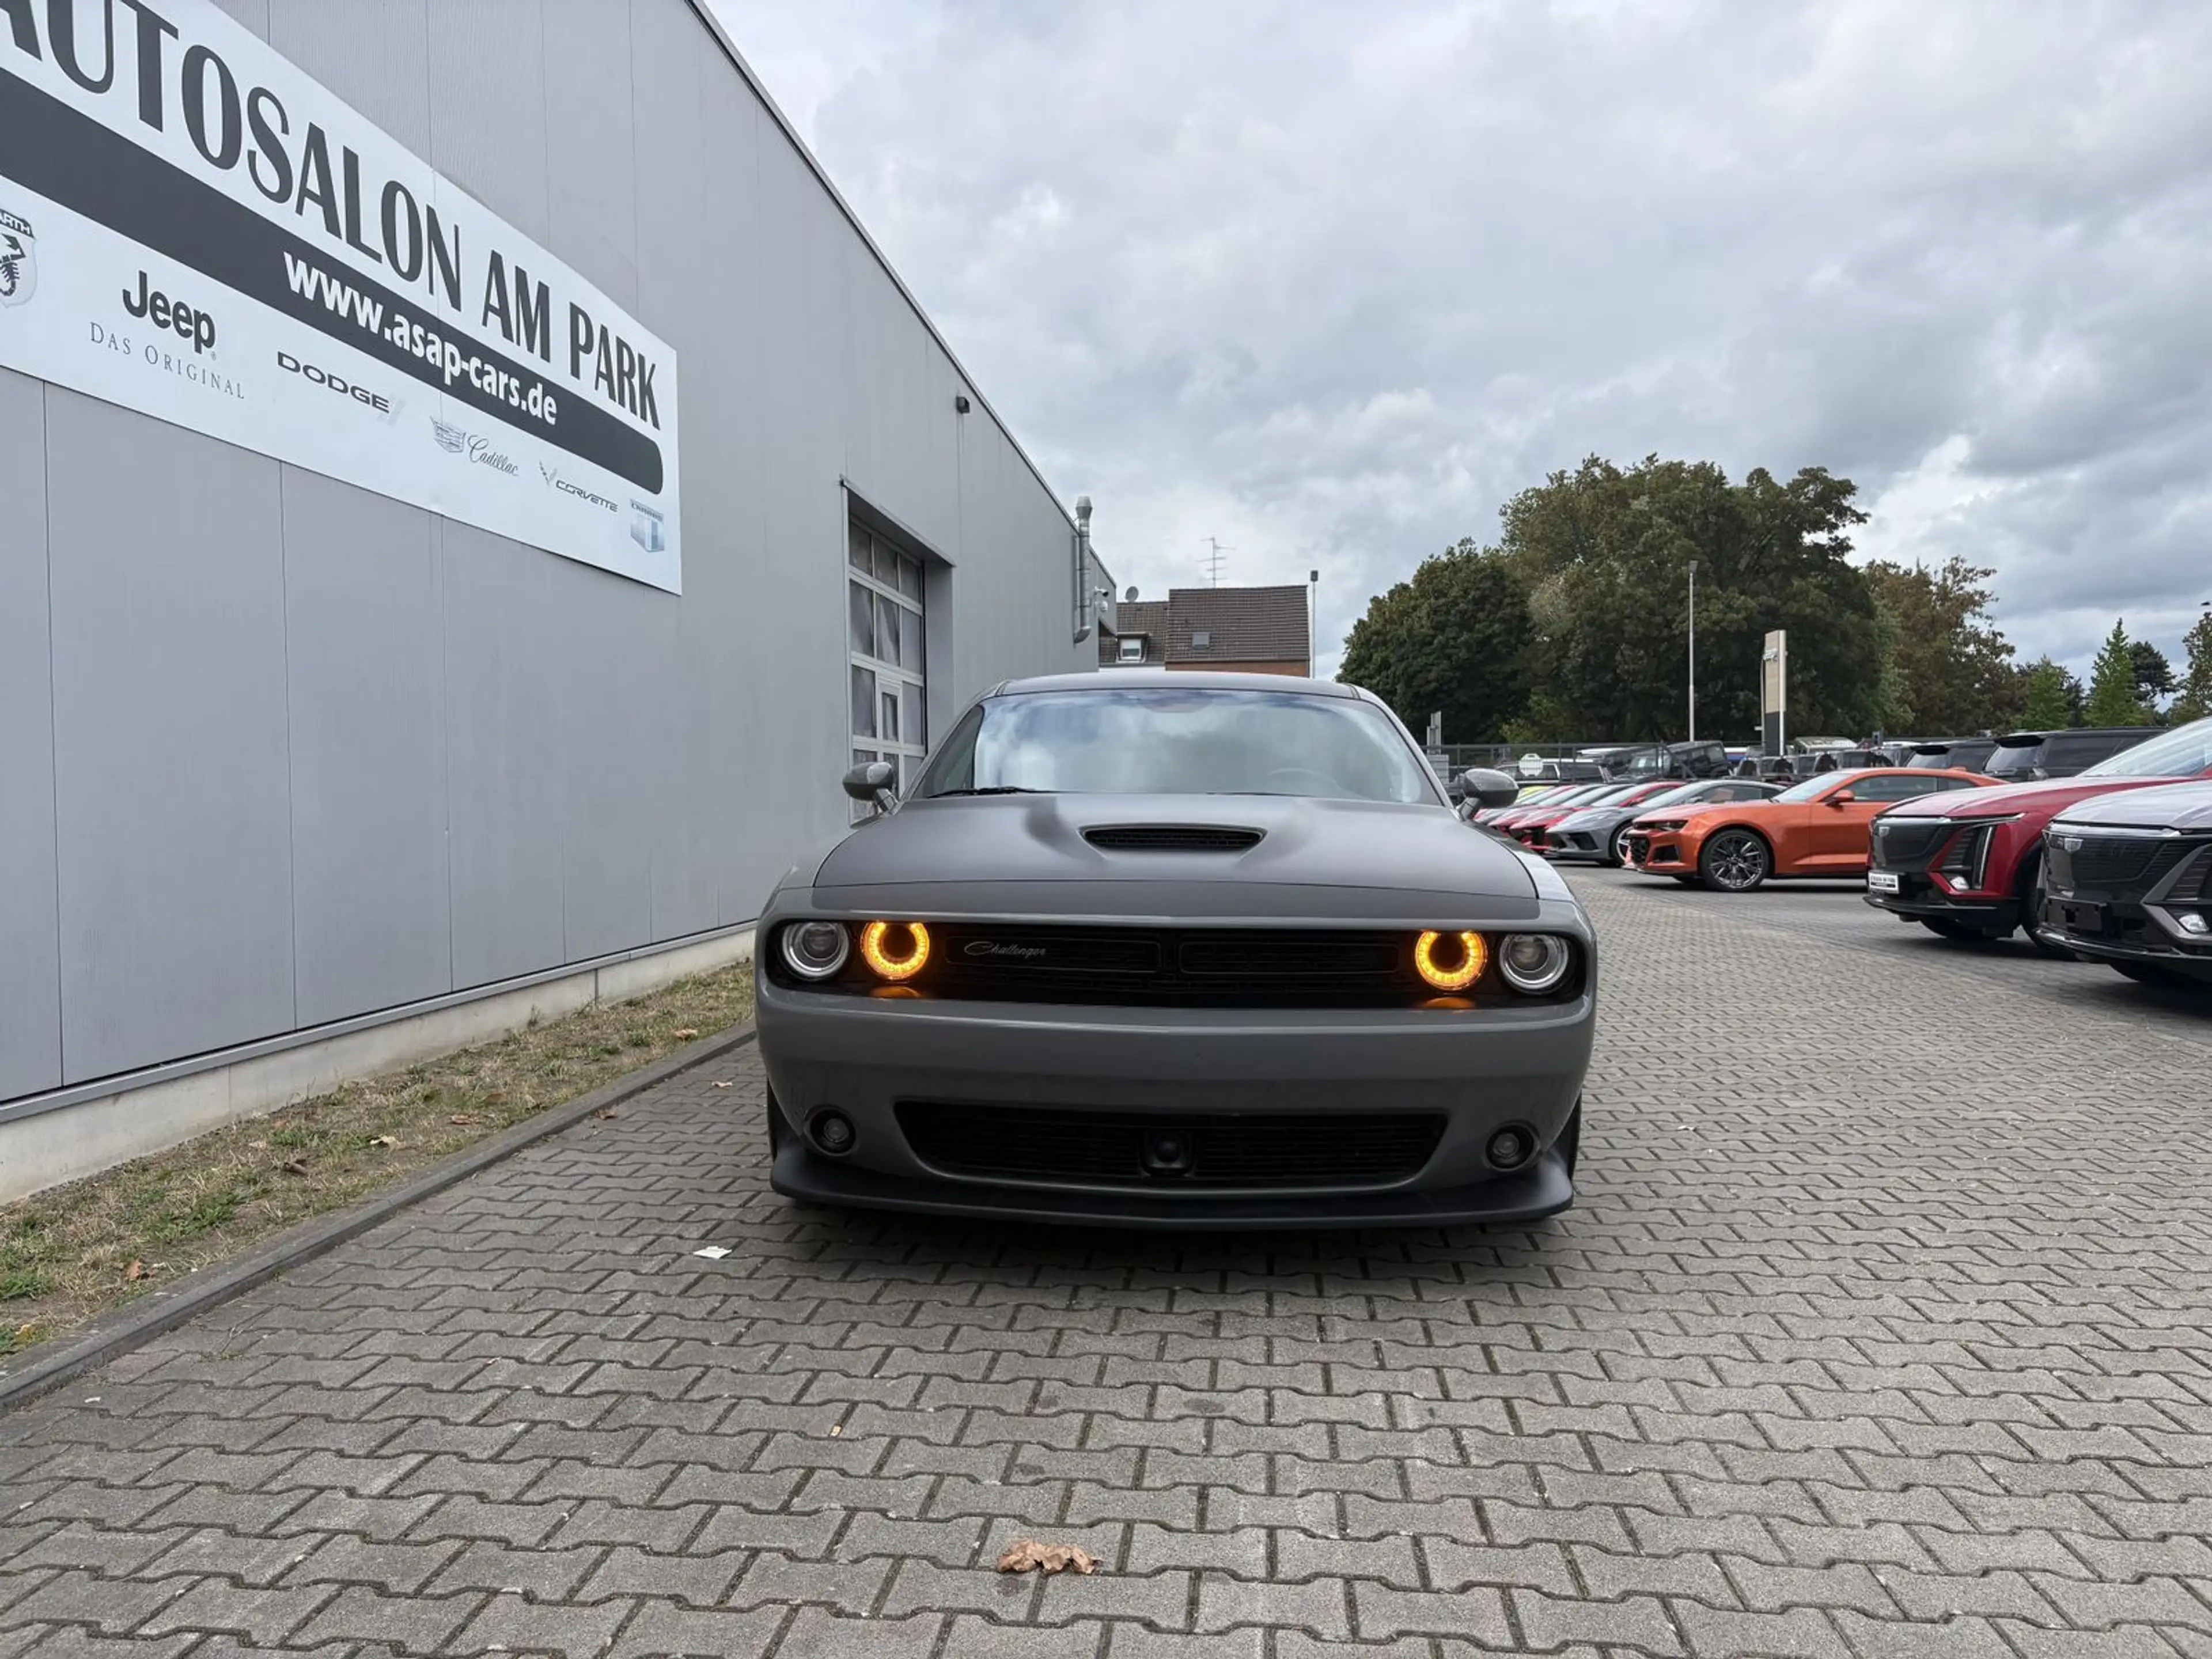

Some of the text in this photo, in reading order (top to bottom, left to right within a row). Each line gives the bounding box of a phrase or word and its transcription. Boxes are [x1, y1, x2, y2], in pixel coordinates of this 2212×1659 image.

[122, 269, 215, 355] Jeep
[283, 251, 558, 426] www.asap-cars.de
[482, 249, 551, 363] AM
[569, 301, 661, 431] PARK
[90, 321, 245, 399] DAS ORIGINAL
[277, 350, 390, 414] DODGE
[467, 435, 520, 477] Cadillac
[555, 479, 619, 513] CORVETTE
[964, 941, 1047, 960] Challenger
